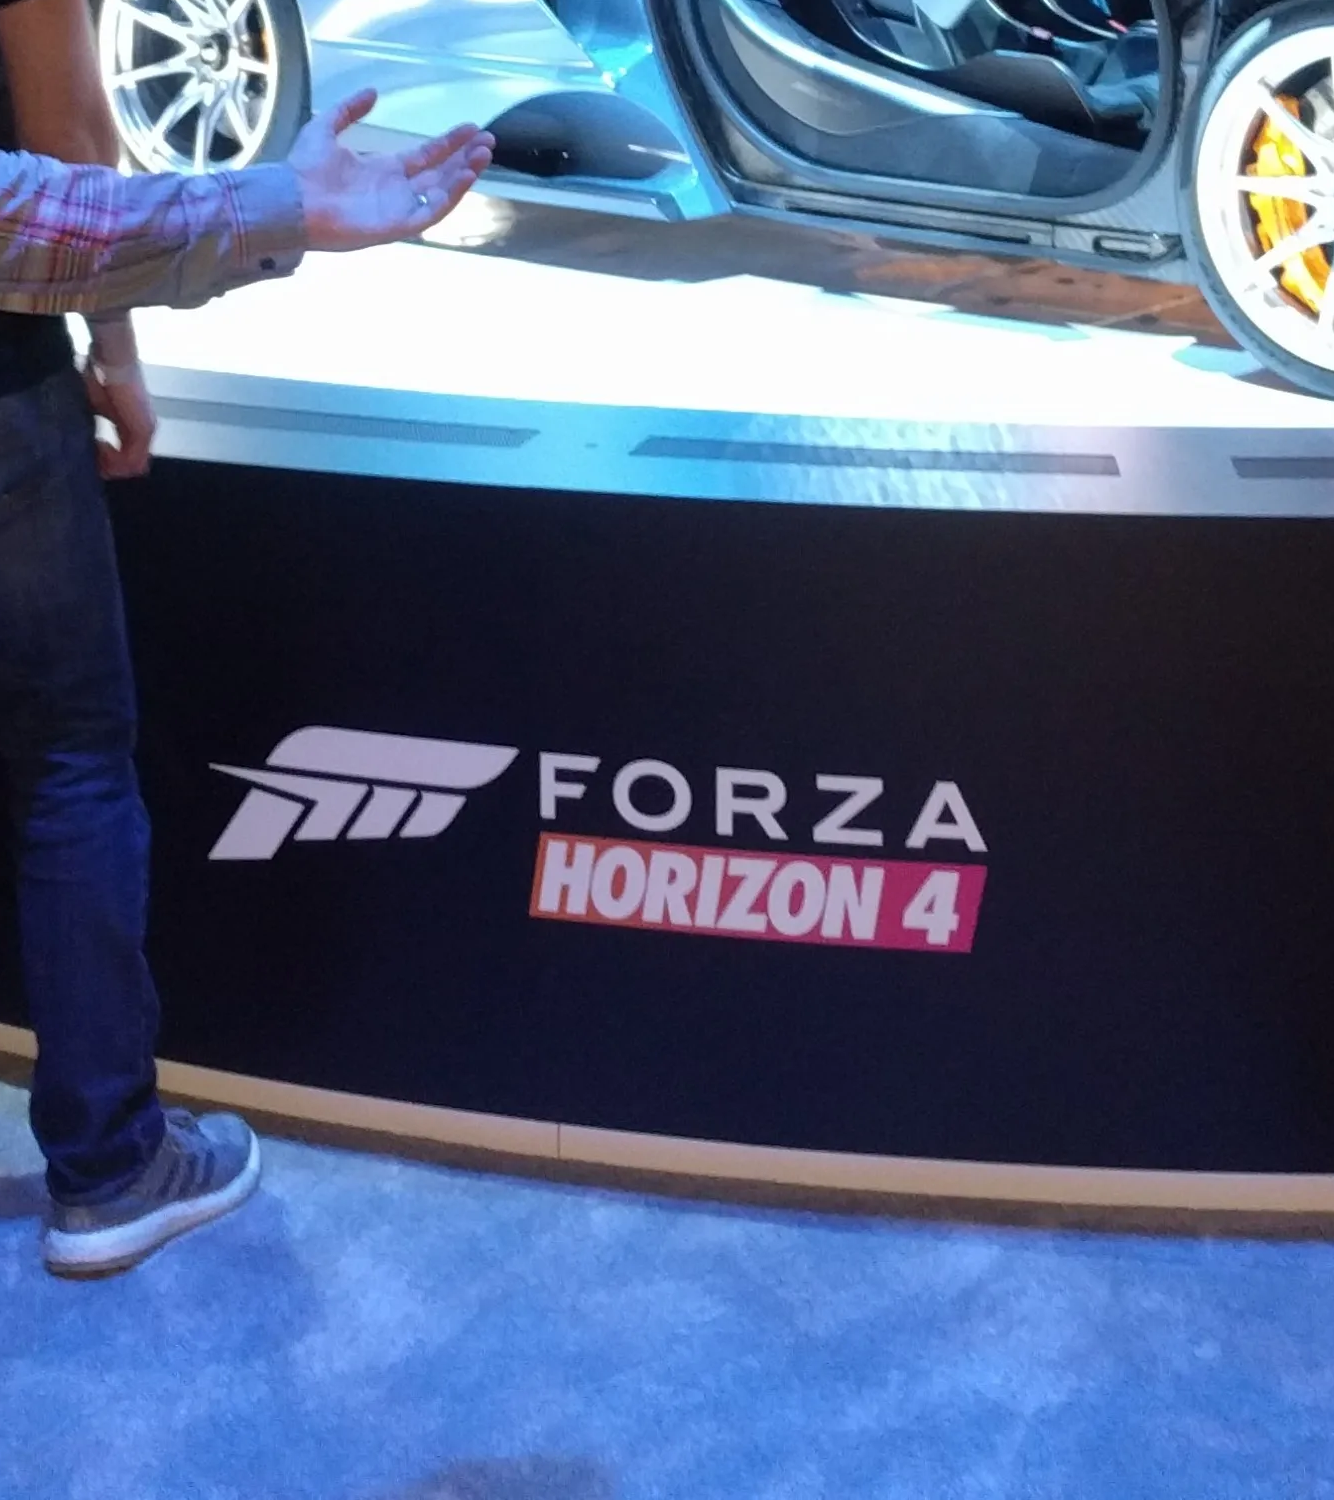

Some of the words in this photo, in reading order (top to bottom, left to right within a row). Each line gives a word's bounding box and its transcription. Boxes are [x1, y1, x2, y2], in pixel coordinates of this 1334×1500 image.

[538, 752, 988, 852] FORZA
[536, 837, 884, 941] HORIZON
[902, 870, 960, 945] 4
